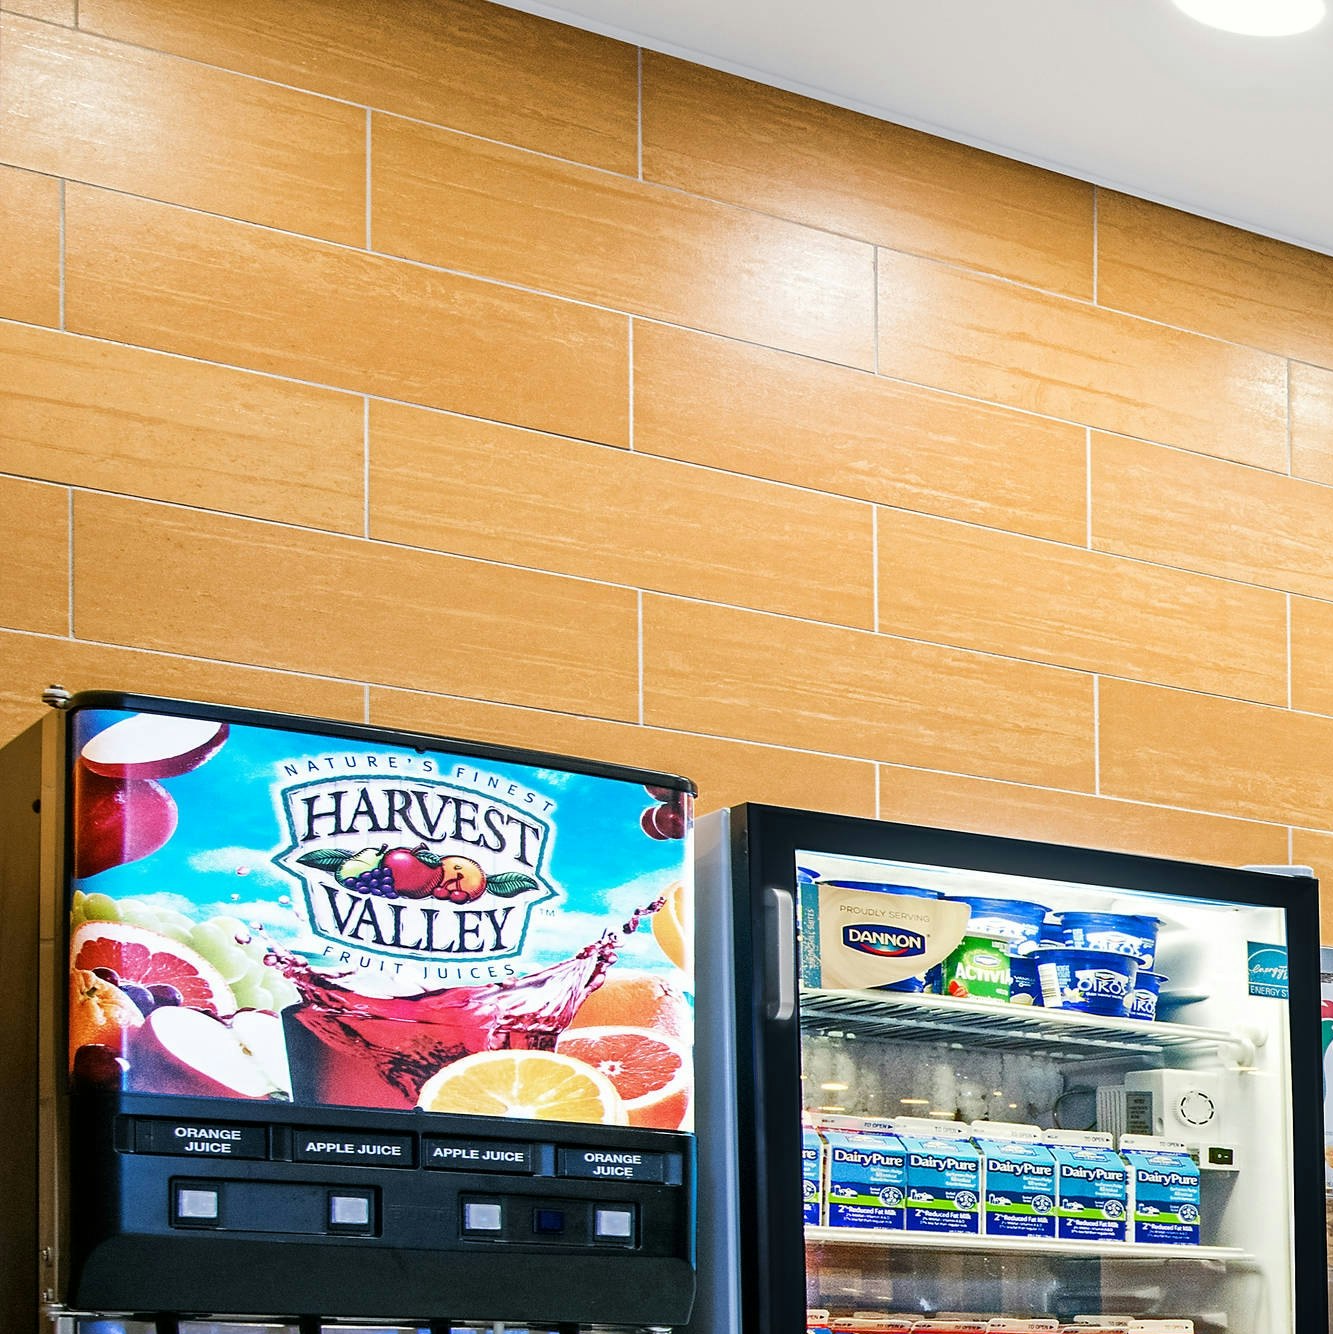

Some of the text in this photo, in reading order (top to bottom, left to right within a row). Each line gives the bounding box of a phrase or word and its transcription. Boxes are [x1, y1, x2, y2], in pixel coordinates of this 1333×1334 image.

[284, 756, 554, 812] NATURE'S FINEST
[300, 787, 540, 867] HARVEST
[320, 882, 516, 952] VALLEY
[840, 905, 930, 923] PROUDLY SERVING
[849, 929, 922, 949] DANNON
[322, 945, 515, 979] FRUIT JUICES
[1078, 979, 1128, 996] OIKOS
[1250, 985, 1280, 996] ENERGY
[175, 1127, 241, 1142] ORANGE
[185, 1141, 231, 1154] JUICE
[306, 1142, 401, 1157] APPLE JUICE
[433, 1148, 524, 1163] APPLE JUICE
[584, 1152, 642, 1165] ORANGE
[834, 1149, 903, 1167] DairyPure
[910, 1154, 977, 1172] DairyPure
[593, 1164, 633, 1177] JUICE
[988, 1159, 1053, 1176] DairyPure
[1062, 1166, 1123, 1181] DairyPure
[1138, 1171, 1198, 1186] DairyPure
